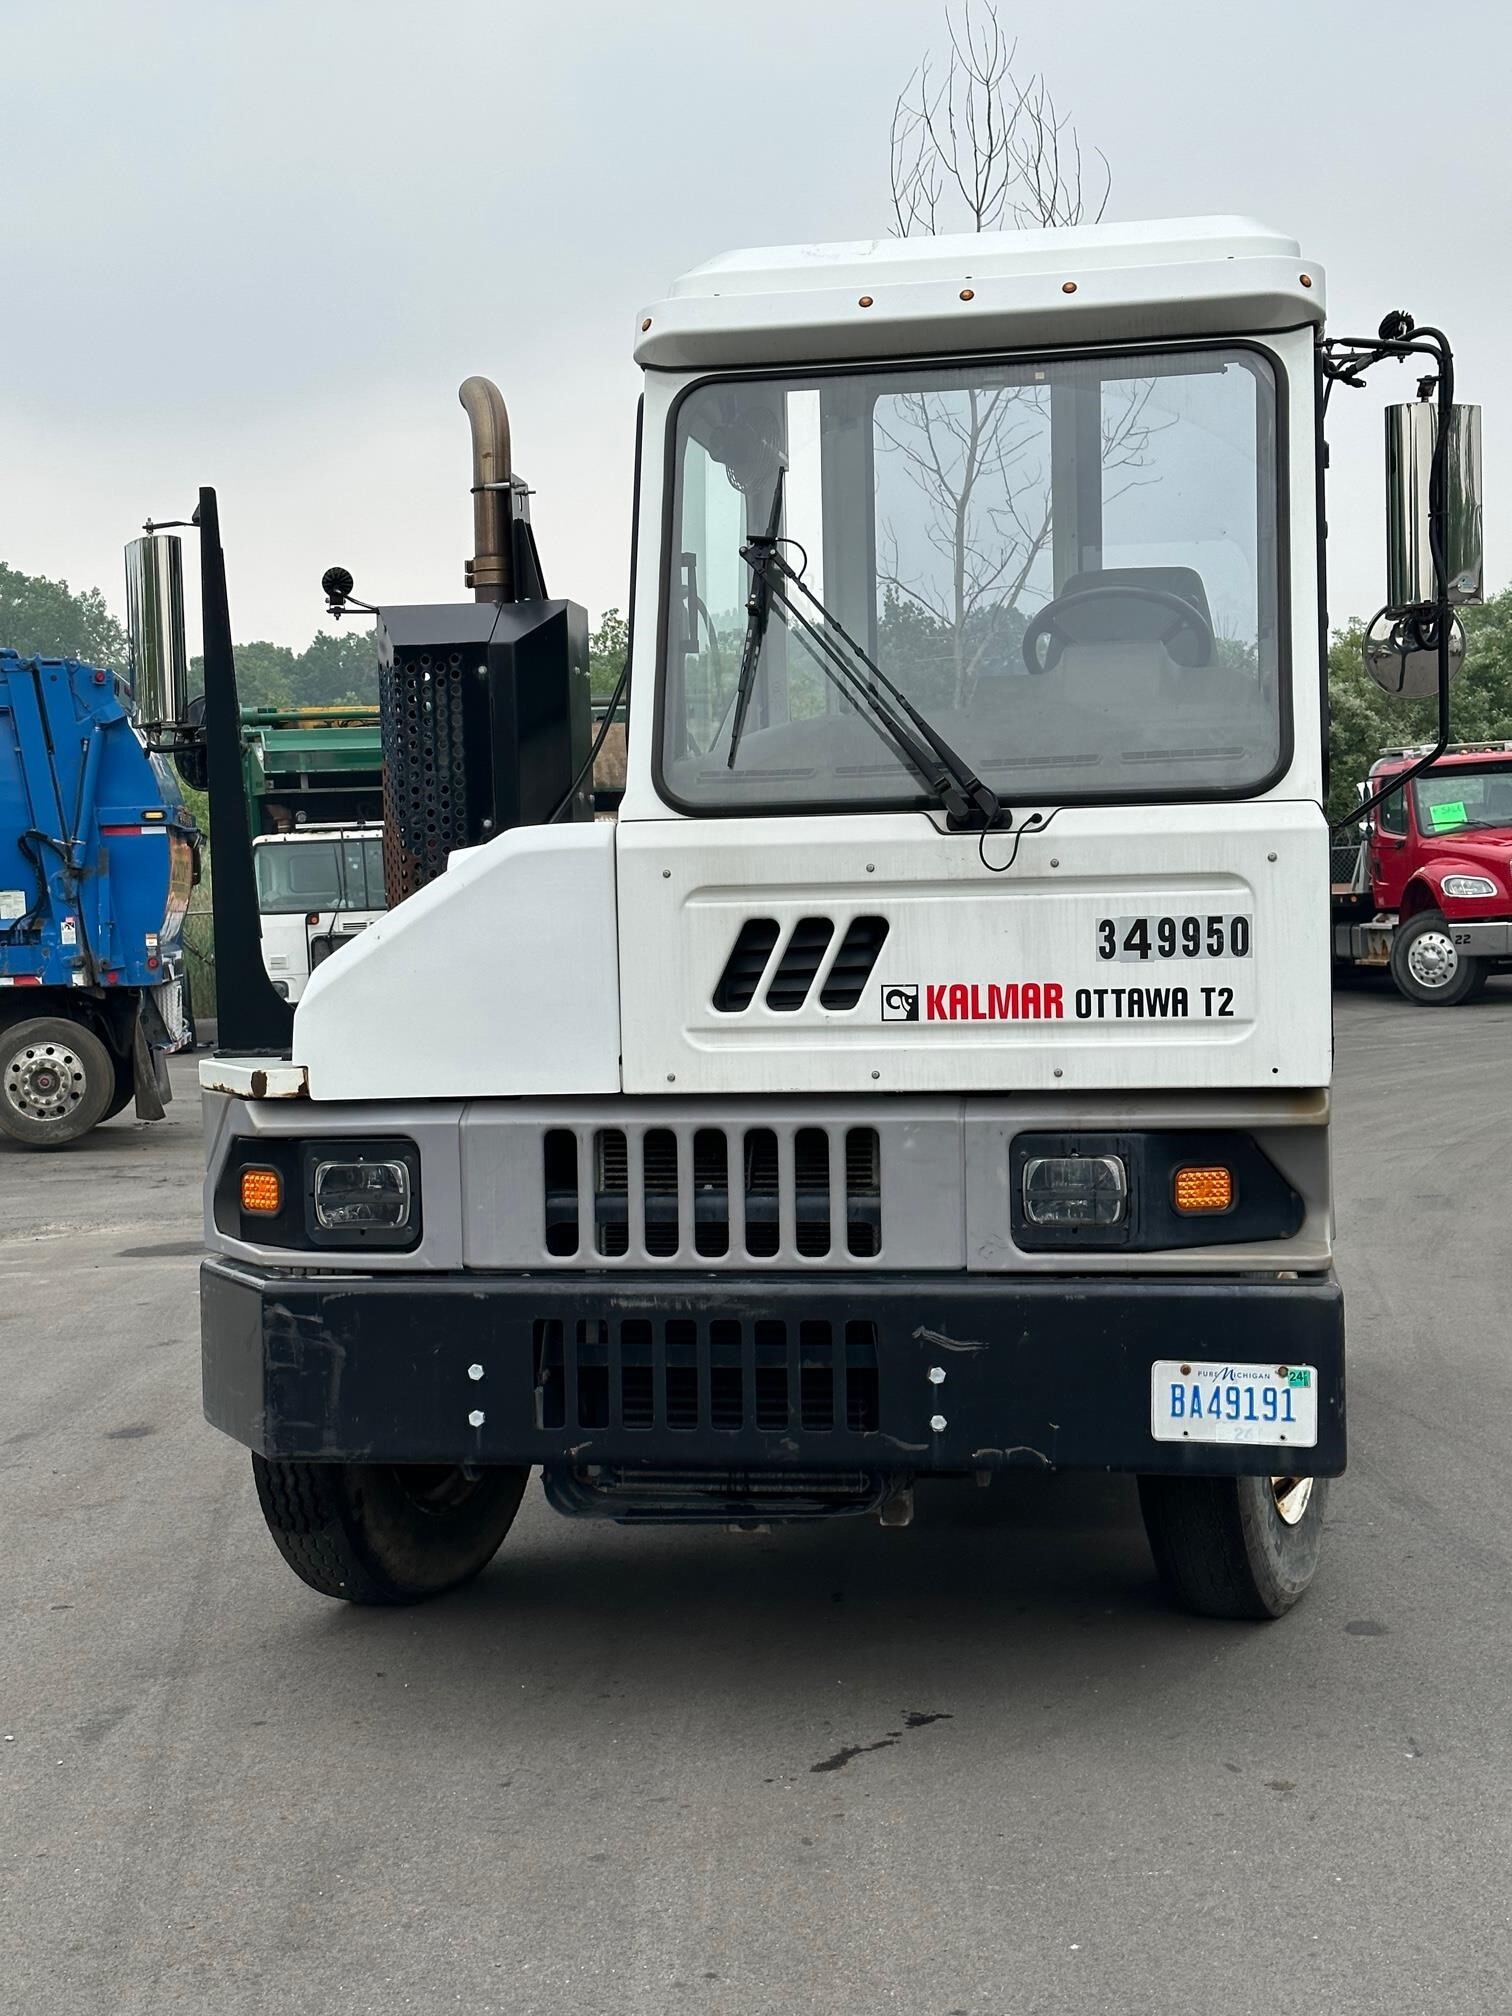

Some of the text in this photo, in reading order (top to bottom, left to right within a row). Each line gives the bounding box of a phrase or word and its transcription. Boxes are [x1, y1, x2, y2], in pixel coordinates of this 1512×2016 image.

[1098, 916, 1250, 960] 349950
[1455, 934, 1471, 945] 22
[926, 983, 1235, 1020] KALMAR OTTAWA T2
[1212, 1366, 1271, 1382] MICHIGAN
[1289, 1371, 1304, 1382] 24
[1170, 1383, 1296, 1423] BA49191
